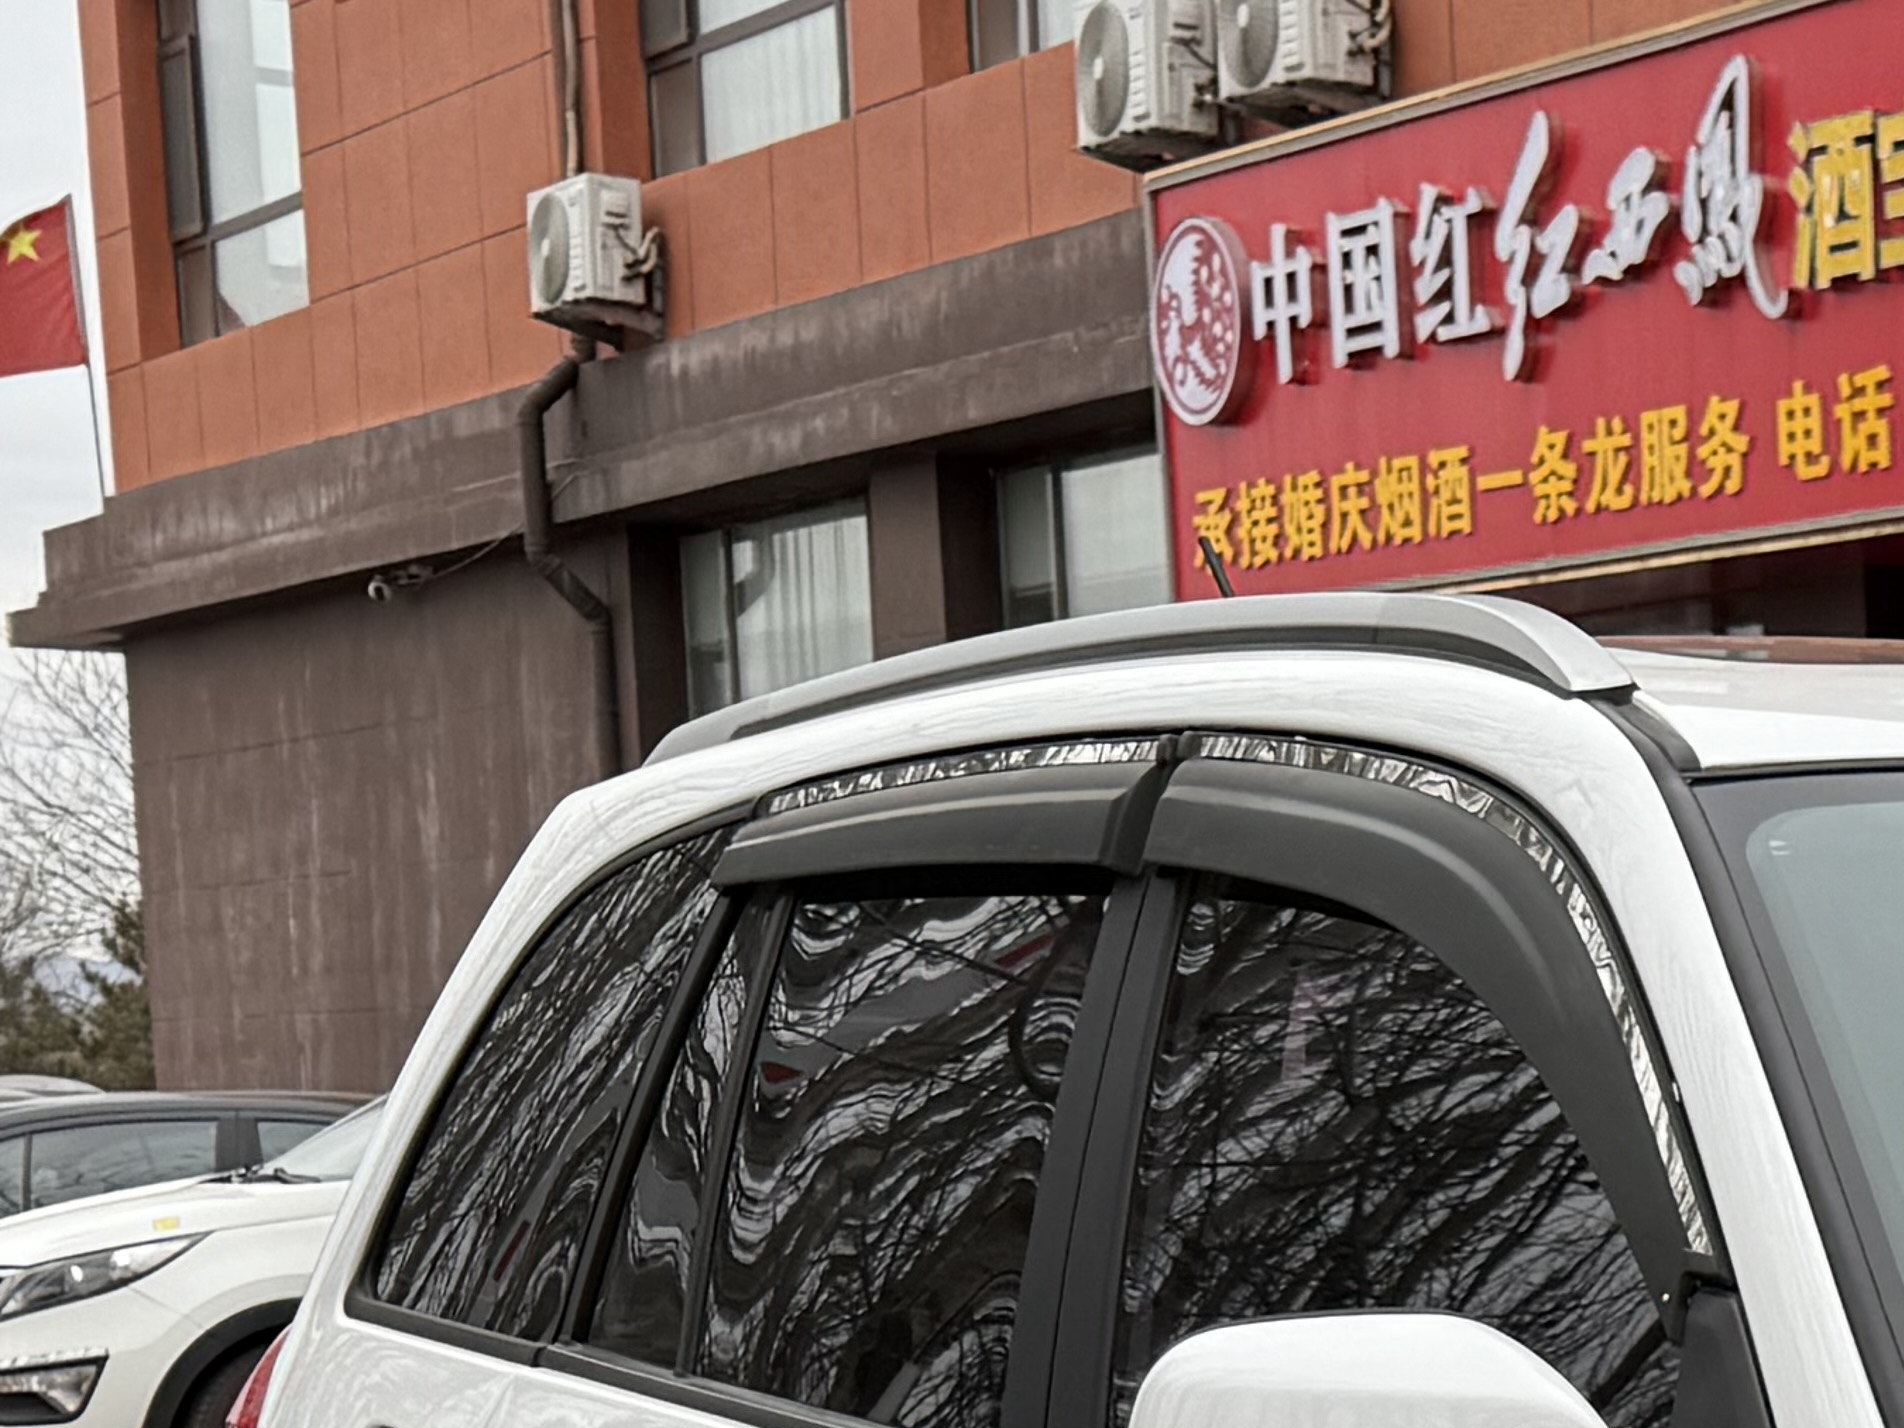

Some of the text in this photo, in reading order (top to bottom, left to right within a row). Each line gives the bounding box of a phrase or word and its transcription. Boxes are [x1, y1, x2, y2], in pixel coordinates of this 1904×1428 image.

[1193, 393, 1751, 572] 承接婚庆烟酒一条龙服务
